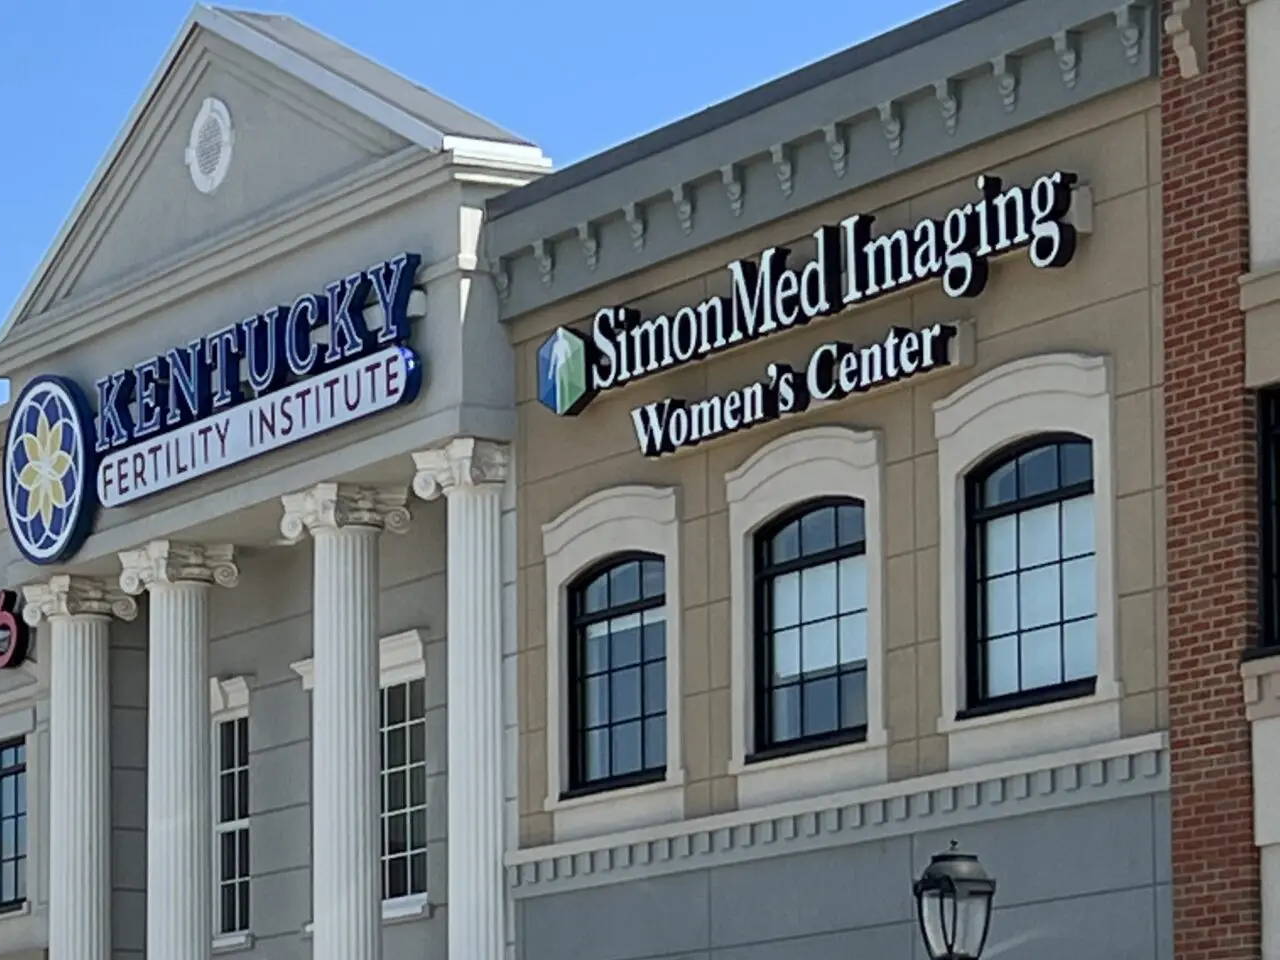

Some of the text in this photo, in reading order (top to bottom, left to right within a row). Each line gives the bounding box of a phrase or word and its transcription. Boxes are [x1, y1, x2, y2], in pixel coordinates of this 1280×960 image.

[94, 252, 415, 452] KENTUCKY
[591, 171, 1067, 389] SimonMed Imaging
[102, 355, 401, 501] FERTILITY INSTITUTE
[631, 323, 948, 459] Women's Center
